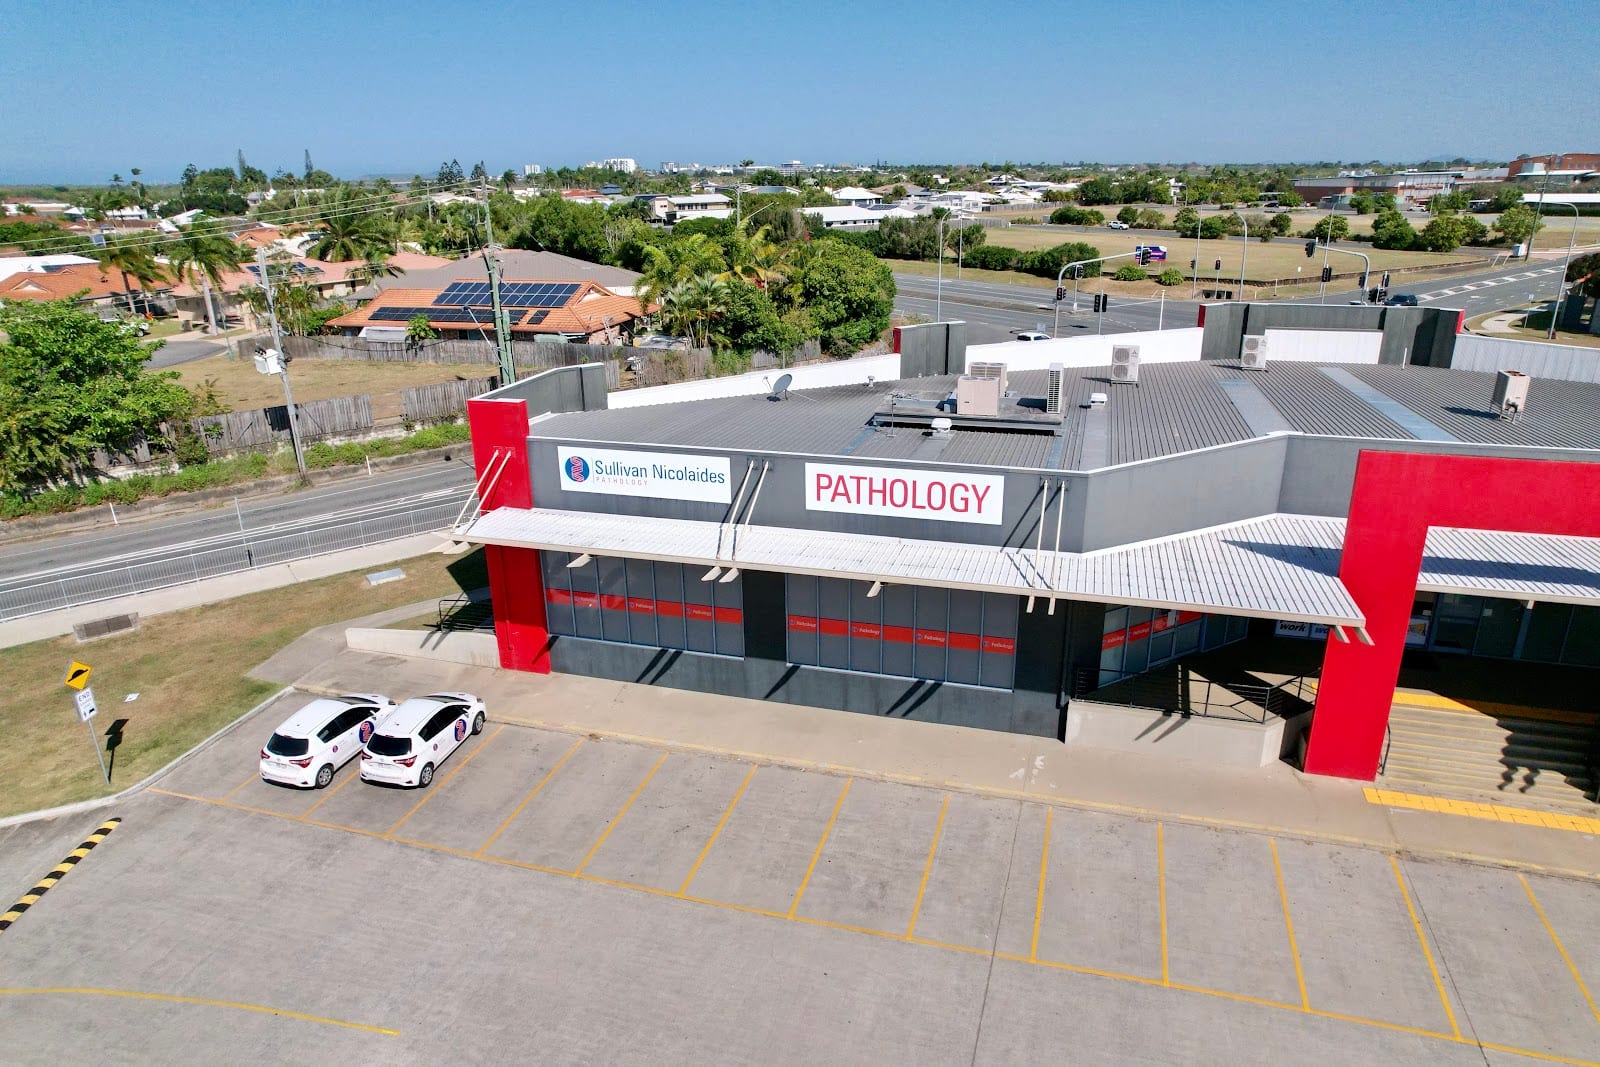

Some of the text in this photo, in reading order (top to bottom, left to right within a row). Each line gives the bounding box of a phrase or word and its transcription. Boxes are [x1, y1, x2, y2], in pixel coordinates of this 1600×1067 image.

[595, 460, 725, 484] Sullivan Nicolaides
[596, 476, 648, 486] PATHOLOGY
[816, 473, 991, 514] PATHOLOGY
[1280, 623, 1306, 632] work
